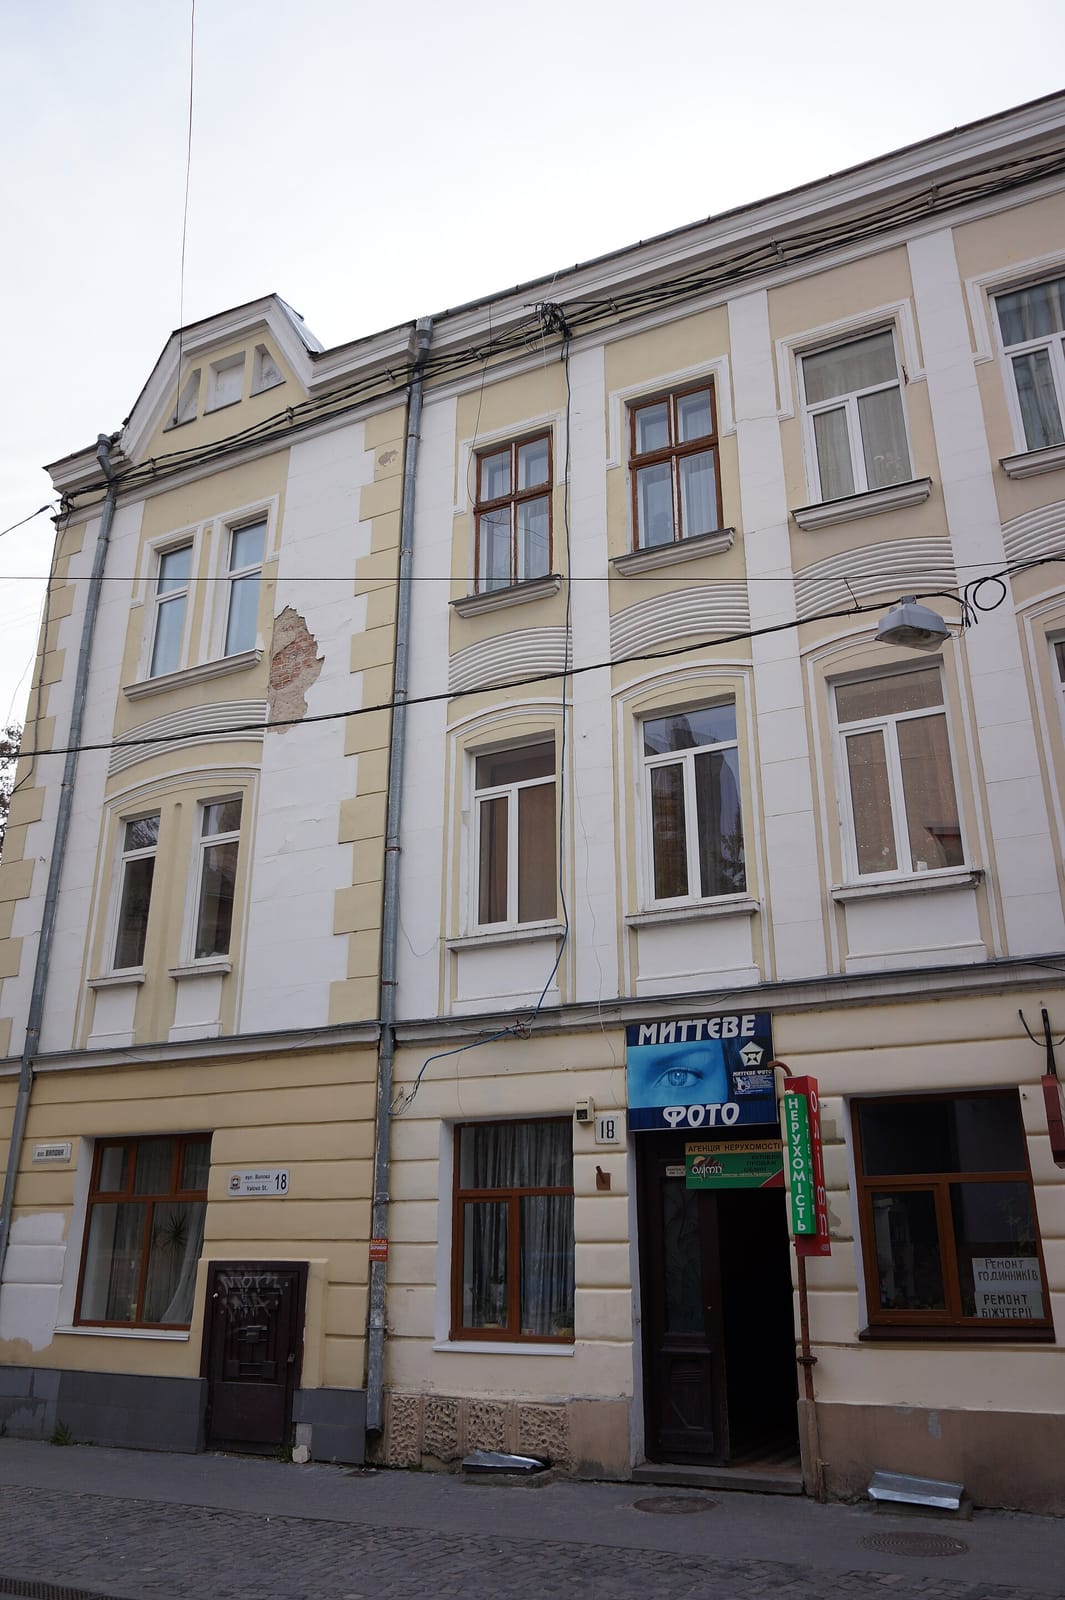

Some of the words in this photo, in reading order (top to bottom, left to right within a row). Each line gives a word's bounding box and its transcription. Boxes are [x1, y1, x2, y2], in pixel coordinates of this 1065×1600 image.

[638, 1014, 756, 1046] МИТТЄВЕ
[662, 1102, 740, 1128] ФОТО
[601, 1120, 614, 1139] 18
[688, 1144, 720, 1152] АГЕНЦІЯ
[724, 1142, 780, 1151] НЕРУХОМОСТІ
[788, 1098, 806, 1231] НЕРУХОМІСТЬ
[275, 1173, 287, 1190] 18
[984, 1295, 1028, 1305] РЕМОНТ
